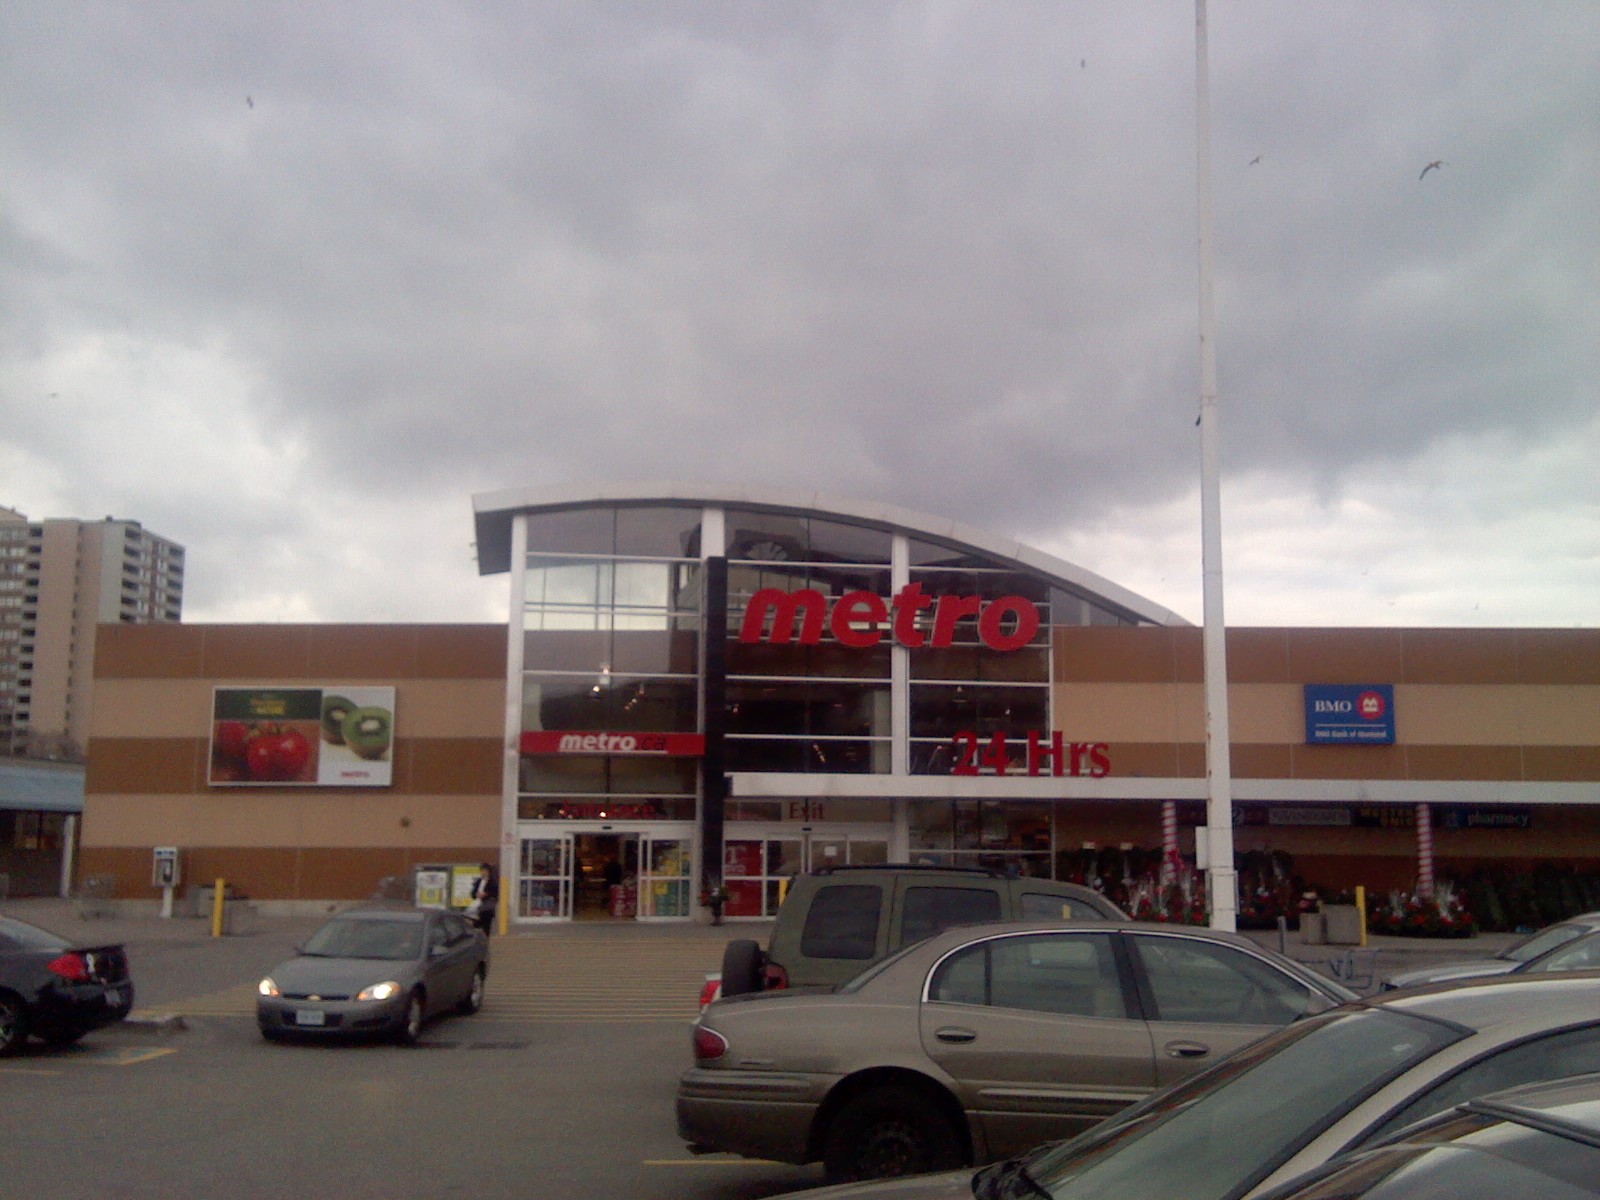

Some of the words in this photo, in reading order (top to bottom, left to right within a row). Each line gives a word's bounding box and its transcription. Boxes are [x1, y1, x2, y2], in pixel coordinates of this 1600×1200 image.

[738, 582, 1041, 652] metro
[1315, 700, 1352, 713] BMO
[951, 730, 1011, 777] 24
[1027, 730, 1112, 778] Hrs
[788, 802, 826, 820] Exit
[1467, 810, 1529, 827] pharmacy
